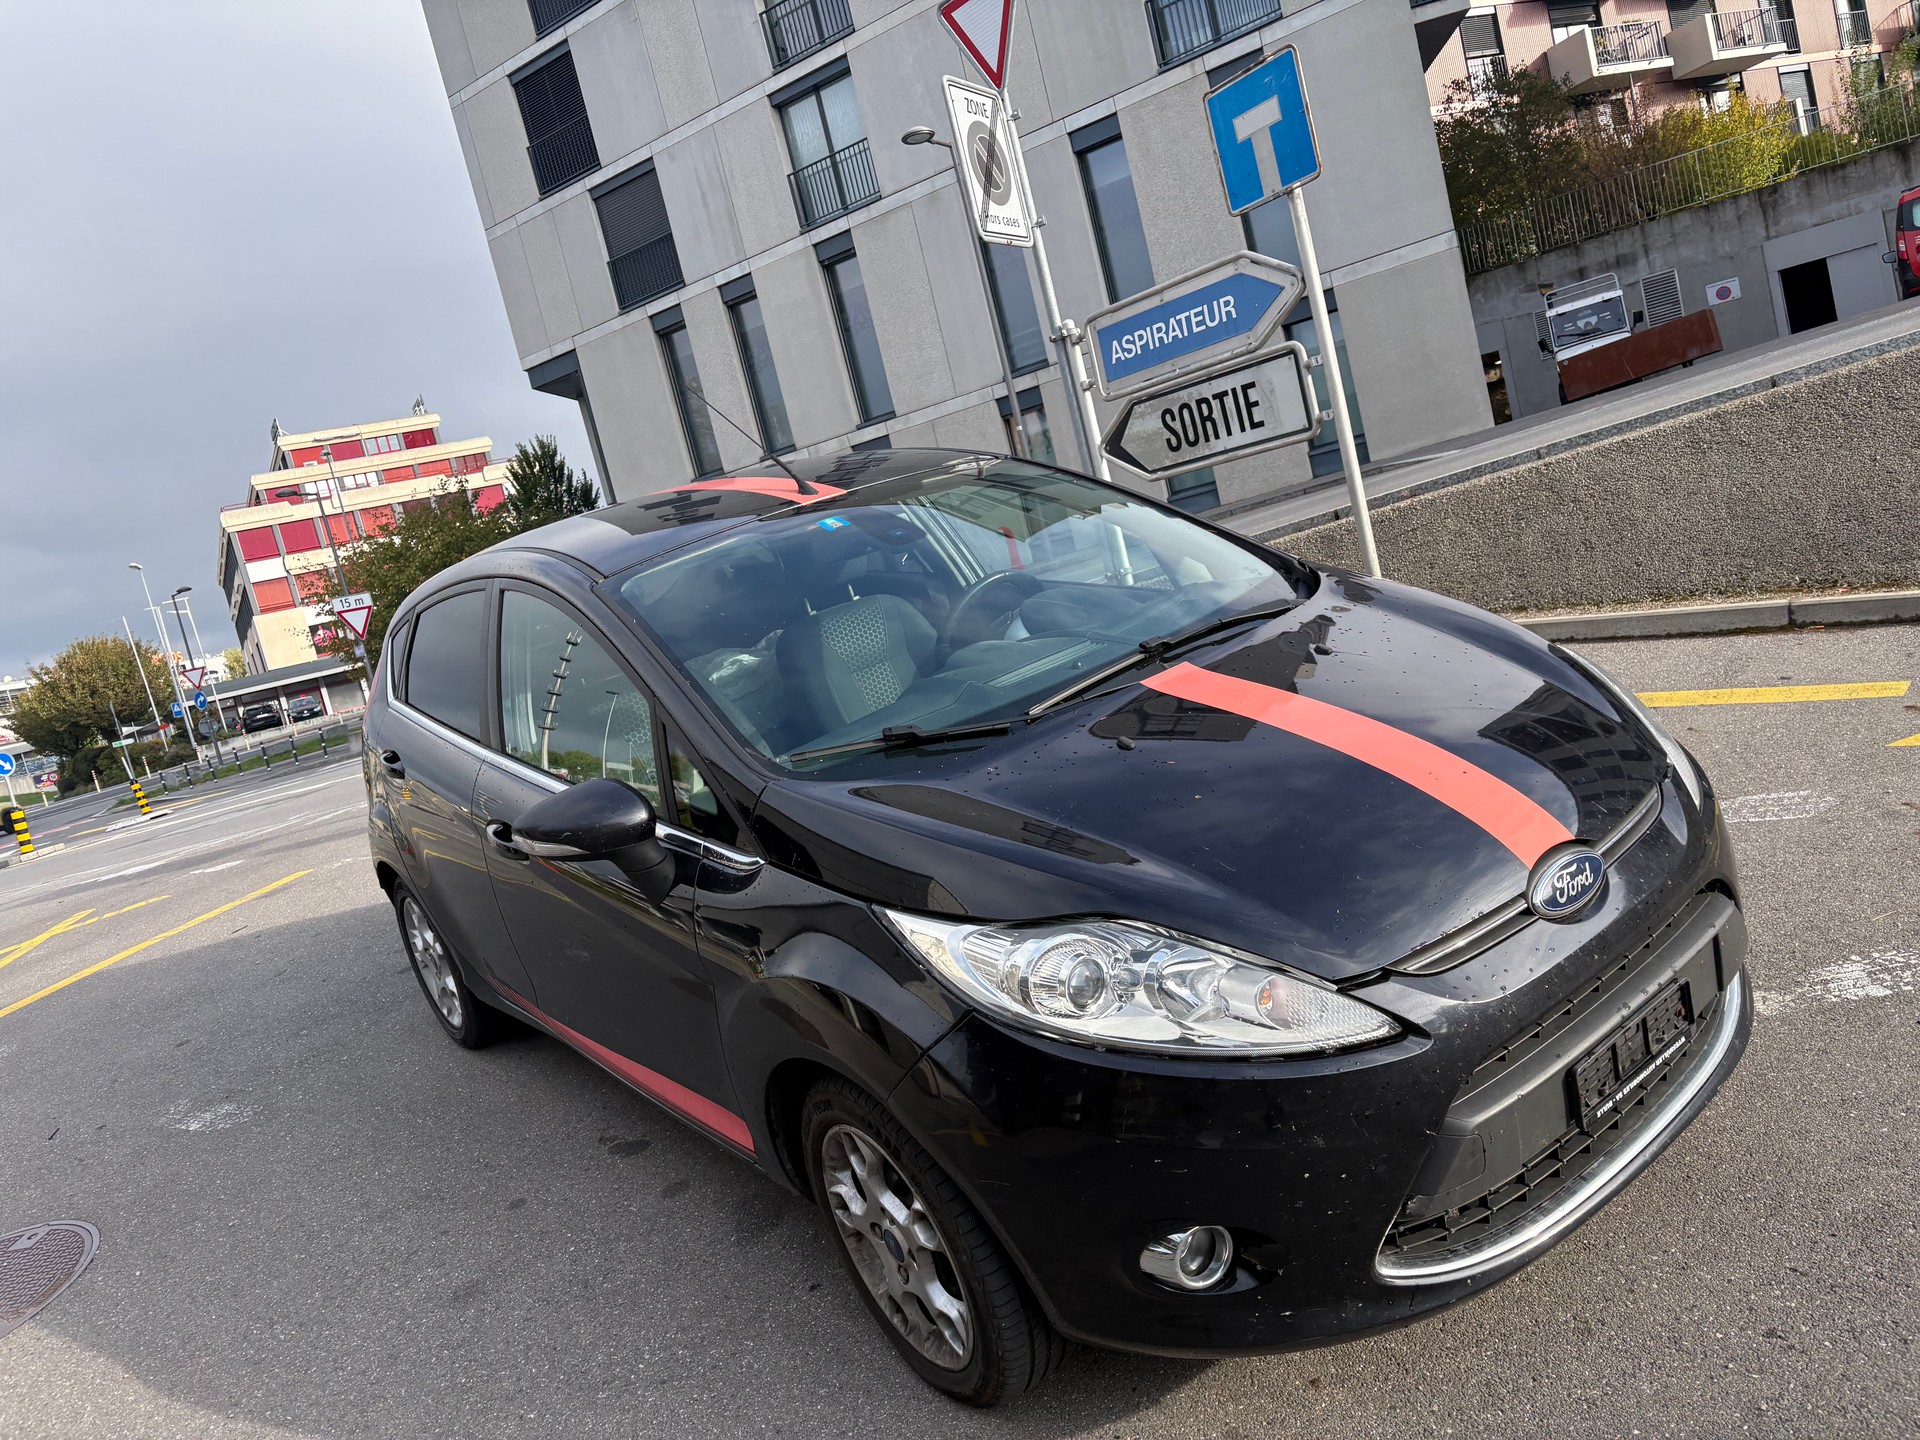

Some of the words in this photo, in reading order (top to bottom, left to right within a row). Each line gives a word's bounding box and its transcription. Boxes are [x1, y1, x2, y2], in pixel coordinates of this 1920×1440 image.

[964, 97, 990, 119] ZONE
[1002, 216, 1020, 228] cases
[1111, 295, 1237, 364] ASPIRATEUR
[1160, 381, 1265, 453] SORTIE
[339, 598, 351, 609] 15
[354, 597, 365, 606] m
[1553, 862, 1594, 904] Ford
[1622, 1062, 1656, 1095] AUTOMOBILES
[1615, 1091, 1624, 1101] SA
[1596, 1100, 1613, 1119] BULLE
